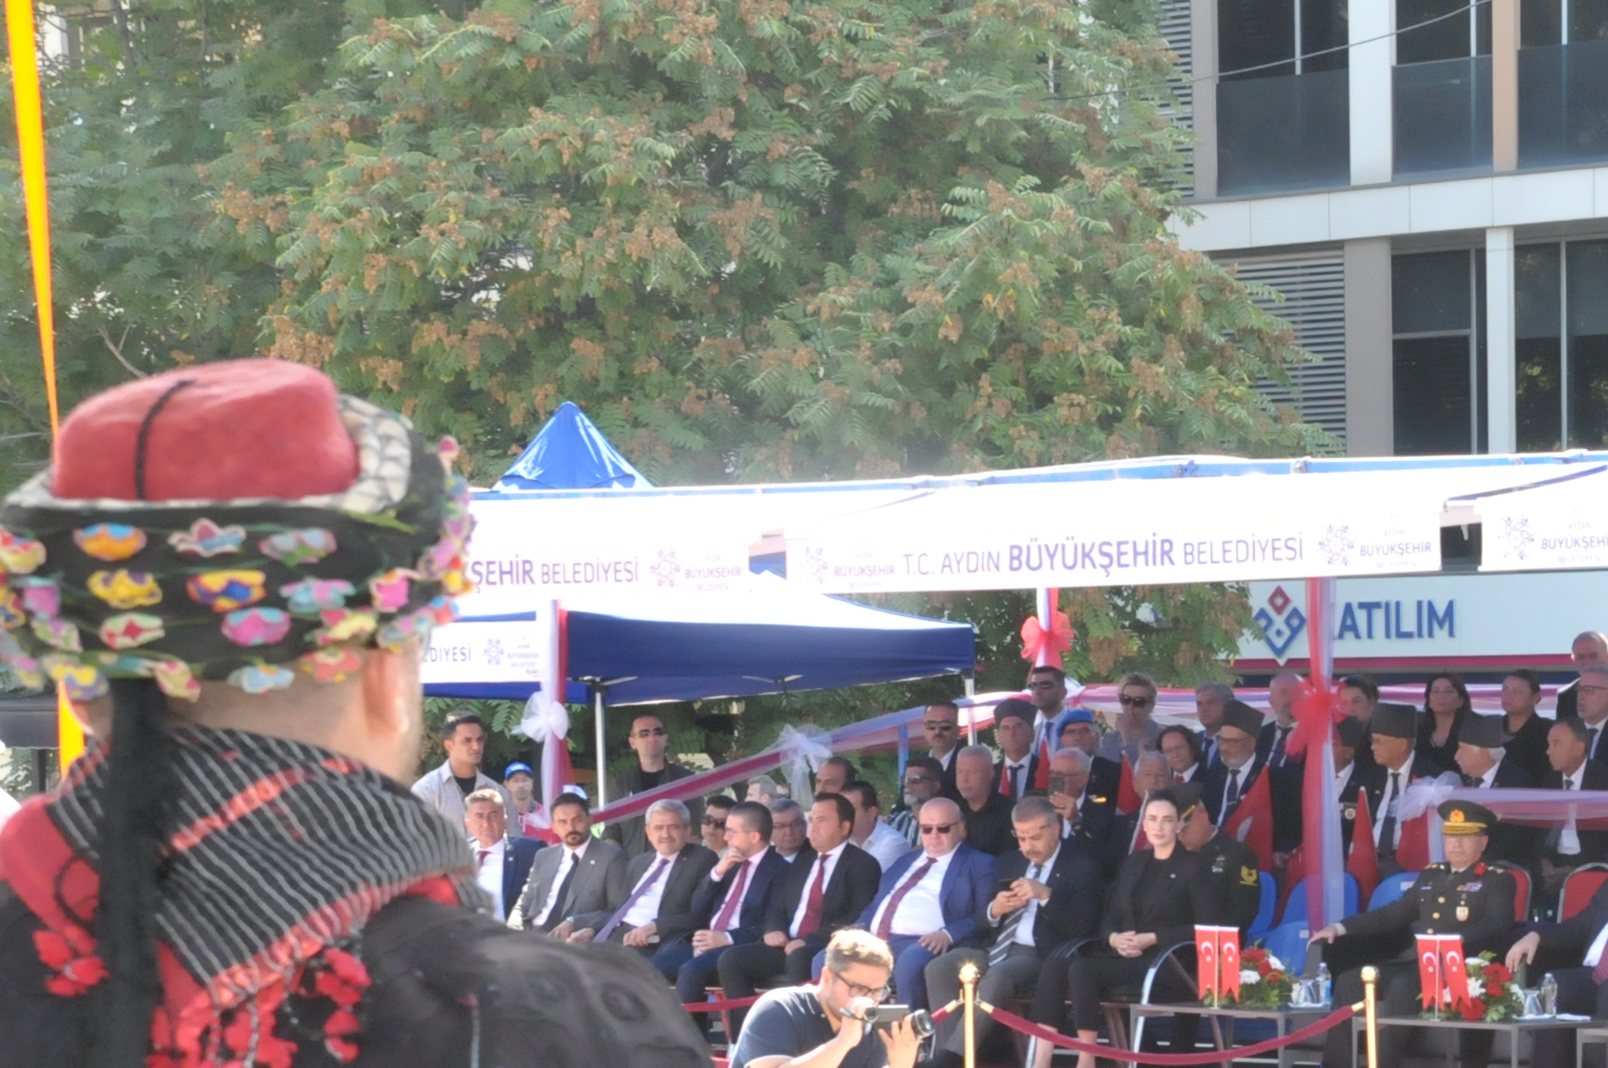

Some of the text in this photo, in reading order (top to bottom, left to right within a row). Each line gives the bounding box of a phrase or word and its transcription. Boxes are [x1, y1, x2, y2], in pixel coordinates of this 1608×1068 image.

[902, 531, 1304, 577] T.C. AYDIN BÜYÜKŞEHİR BELEDİYESİ
[1359, 540, 1432, 558] BÜYÜKŞEHİR
[466, 553, 639, 594] ŞEHİR BELEDİYESİ
[684, 565, 742, 580] BÜYÜKŞEHİR
[834, 563, 896, 579] BÜYÜKŞEHİR
[1334, 598, 1457, 641] ATILIM
[425, 643, 472, 663] DİYESİ
